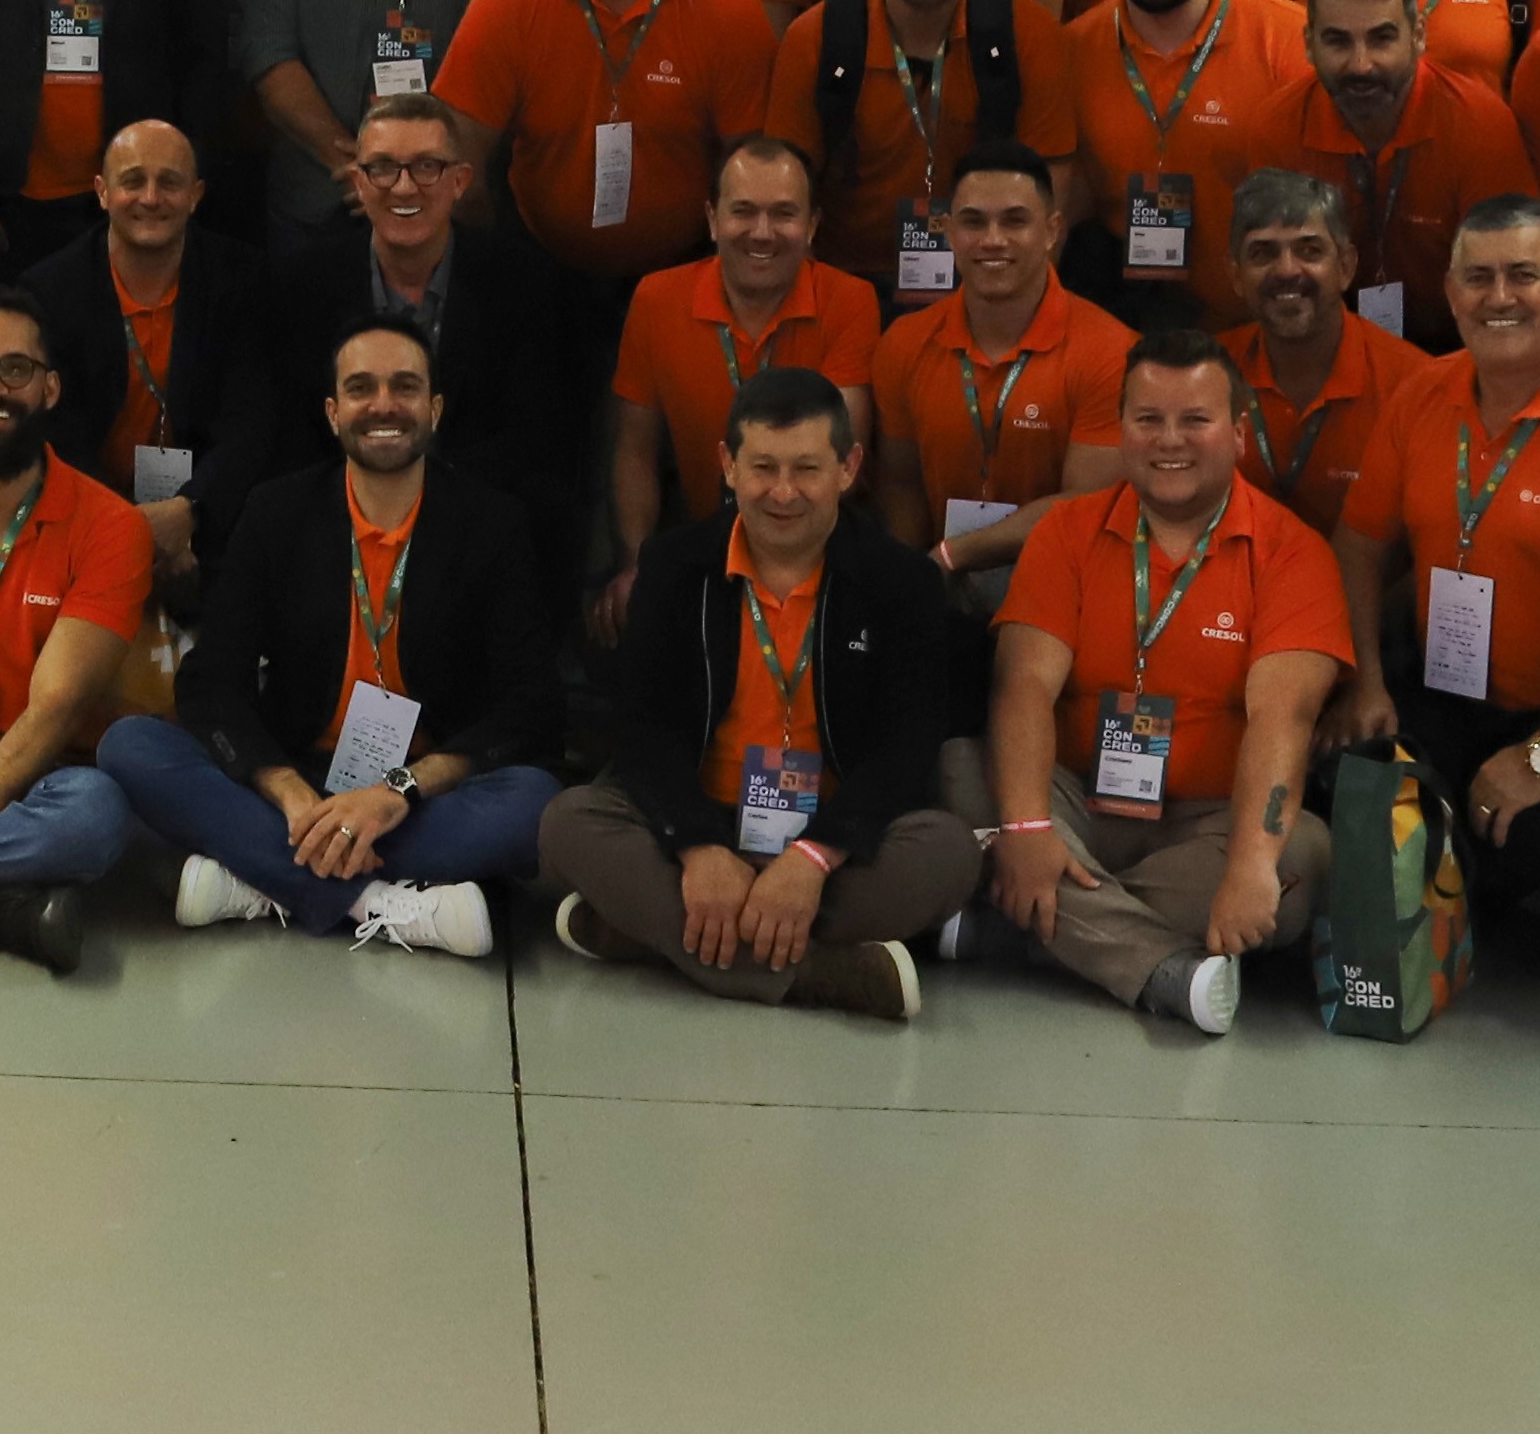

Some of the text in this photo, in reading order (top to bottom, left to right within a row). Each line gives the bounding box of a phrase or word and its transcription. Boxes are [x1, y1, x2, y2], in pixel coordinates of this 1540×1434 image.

[50, 18, 75, 26] CON
[50, 26, 84, 35] CRED
[377, 41, 402, 49] CON
[377, 49, 411, 57] CRED
[1132, 207, 1160, 216] CON
[1132, 216, 1168, 226] CRED
[902, 231, 929, 240] CON
[902, 240, 938, 250] CRED
[27, 594, 61, 607] CRESO
[1201, 627, 1246, 642] CRESOL
[1103, 729, 1134, 742] CON
[1102, 739, 1143, 753] CRED
[748, 784, 780, 797] CON
[747, 795, 789, 810] CRED
[1344, 979, 1381, 995] CON
[1345, 994, 1396, 1010] CRED
